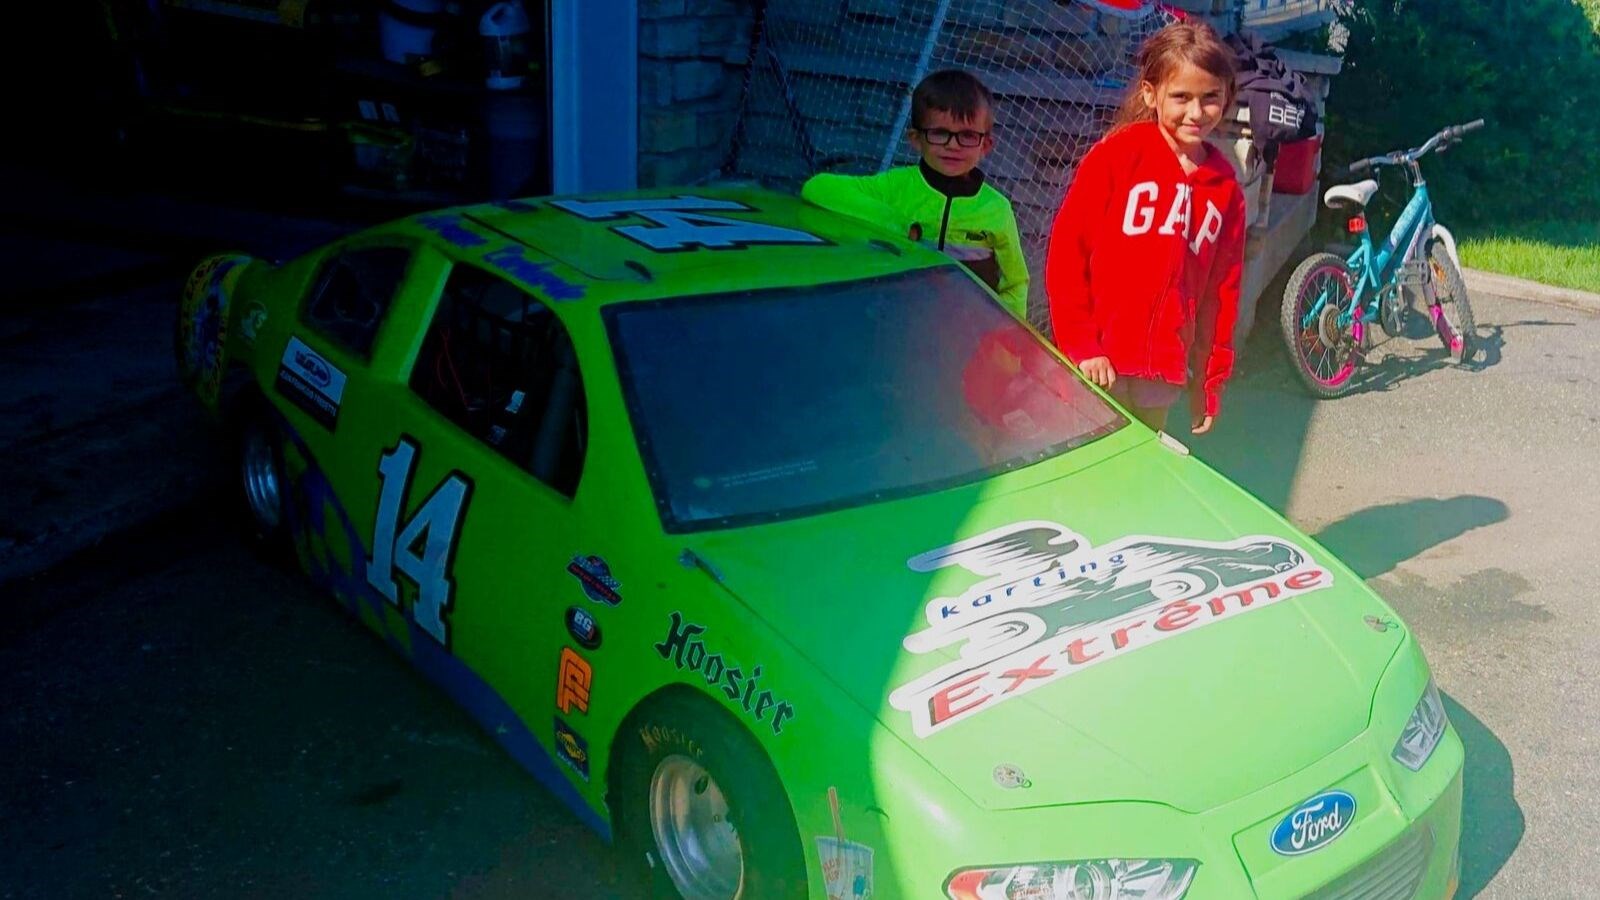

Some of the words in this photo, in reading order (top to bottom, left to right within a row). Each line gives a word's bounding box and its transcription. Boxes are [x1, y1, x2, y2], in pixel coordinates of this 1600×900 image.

[1122, 181, 1222, 256] GAP
[366, 435, 472, 648] 14
[941, 552, 1125, 619] karting
[654, 611, 794, 735] Hoosier
[928, 569, 1324, 728] Extrême
[1291, 801, 1342, 849] Ford
